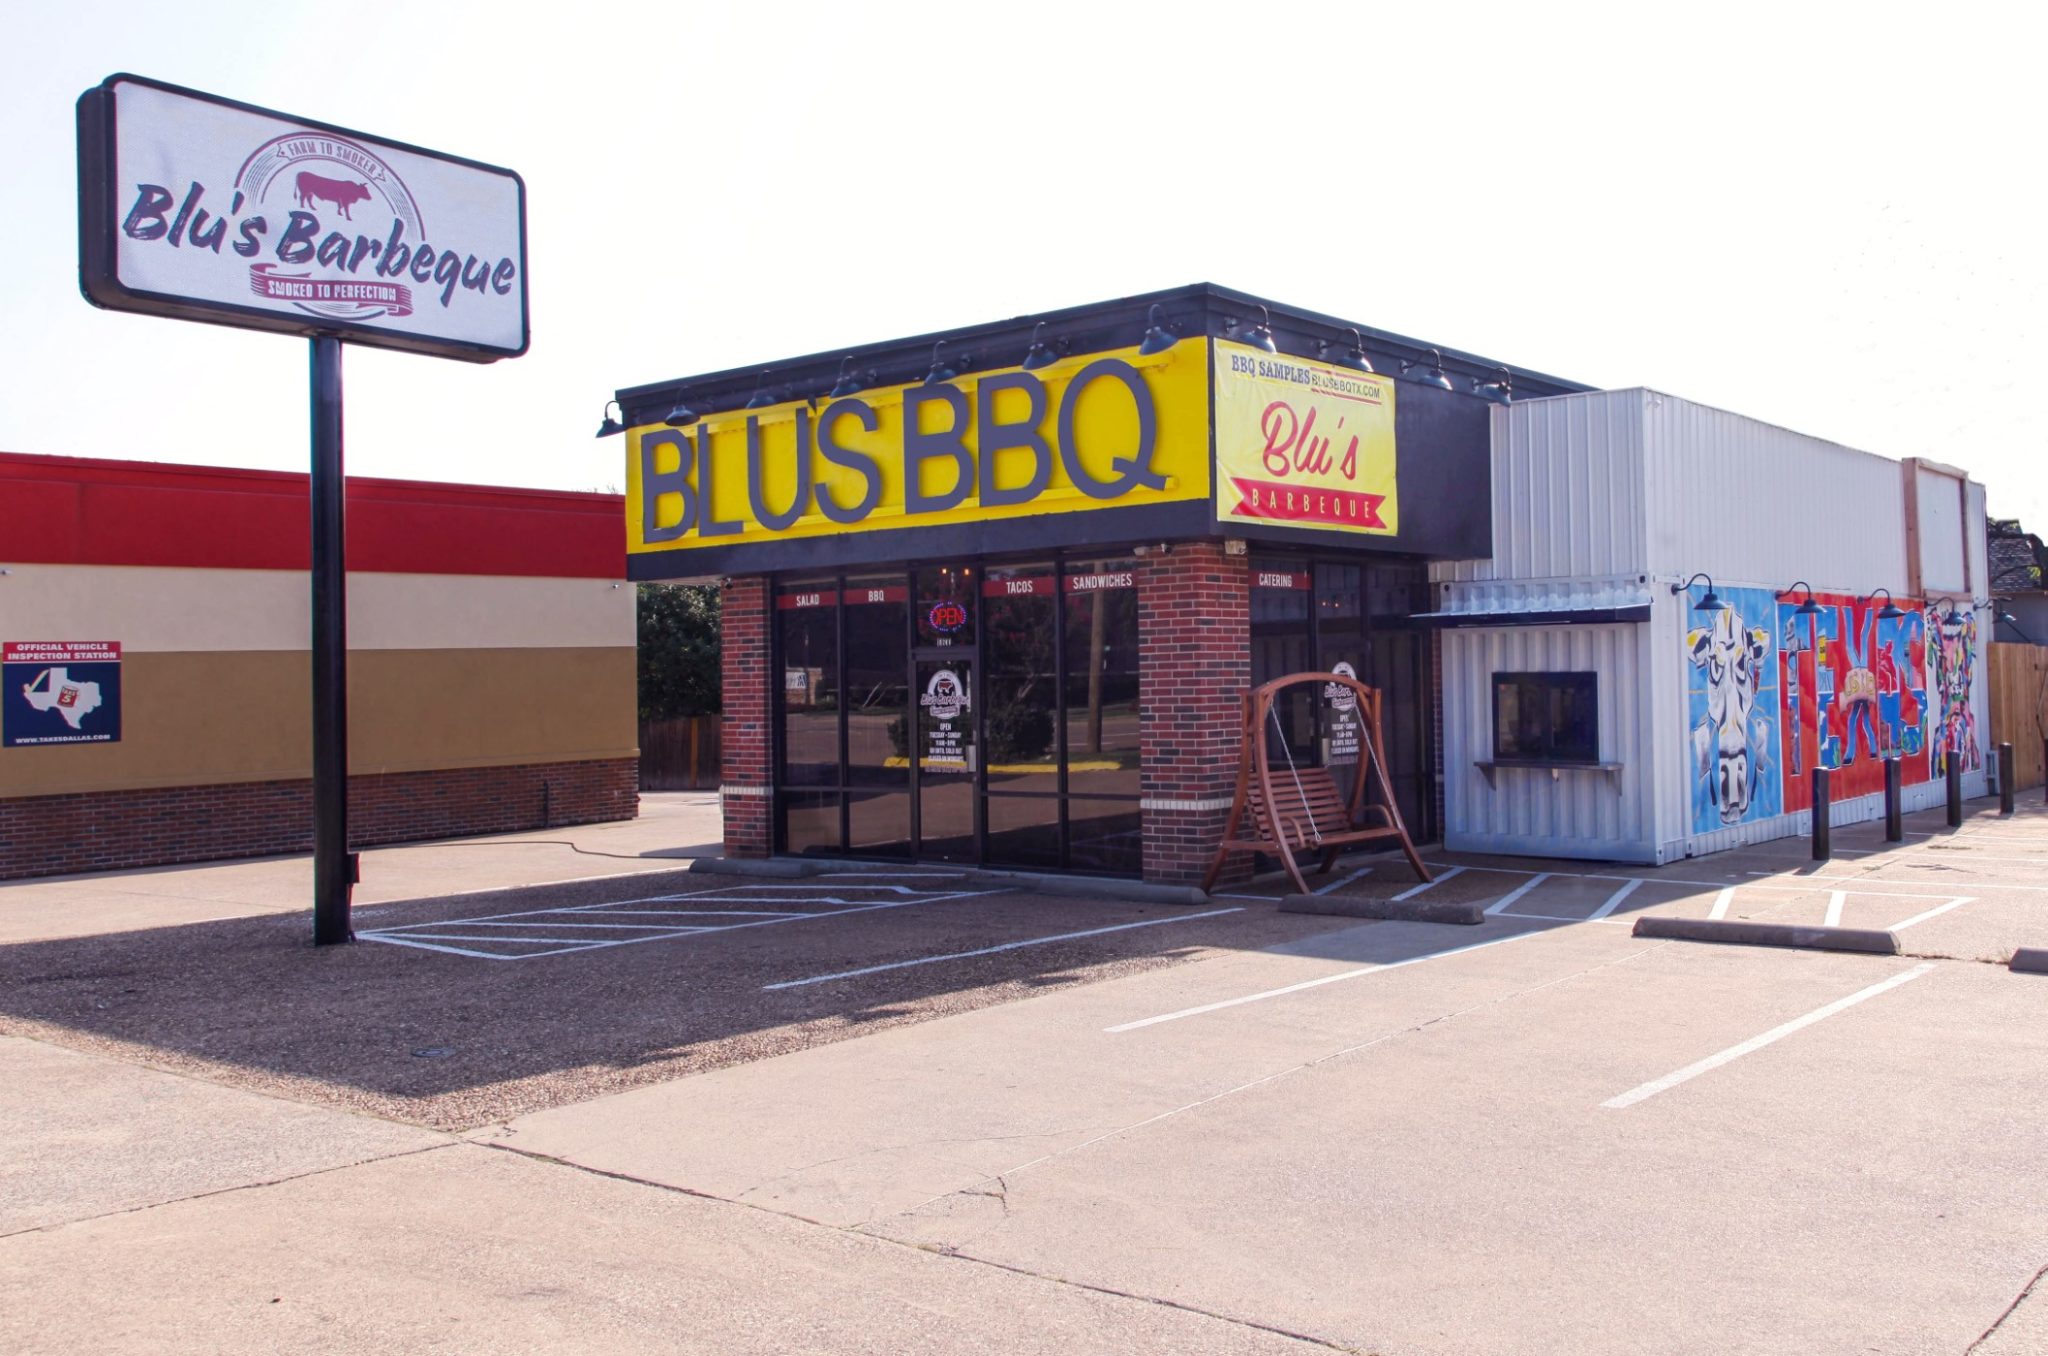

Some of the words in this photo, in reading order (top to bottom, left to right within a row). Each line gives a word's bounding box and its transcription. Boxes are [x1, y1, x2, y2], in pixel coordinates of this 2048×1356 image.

[287, 141, 316, 156] FARM
[320, 141, 333, 155] TO
[336, 146, 377, 174] SMOKER
[122, 181, 267, 257] Blu's
[276, 210, 516, 307] Barbeque
[268, 280, 313, 297] SMOKED
[317, 284, 331, 298] TO
[334, 284, 397, 301] PERFECTION
[1231, 354, 1256, 378] BBQ
[1259, 361, 1311, 385] SAMPLES
[903, 358, 1168, 515] BBQ
[1261, 400, 1359, 481] Blu's
[1252, 488, 1370, 519] BARBEQUE
[1006, 580, 1033, 594] TACOS
[1073, 573, 1133, 590] SANDWICHES
[1259, 573, 1293, 588] CATERING
[796, 594, 820, 607] SALAD
[868, 590, 885, 602] BBQ
[933, 607, 965, 625] OPEN
[17, 643, 64, 651] OFFICIAL
[8, 652, 71, 660] INSPECTION
[62, 694, 71, 703] 5
